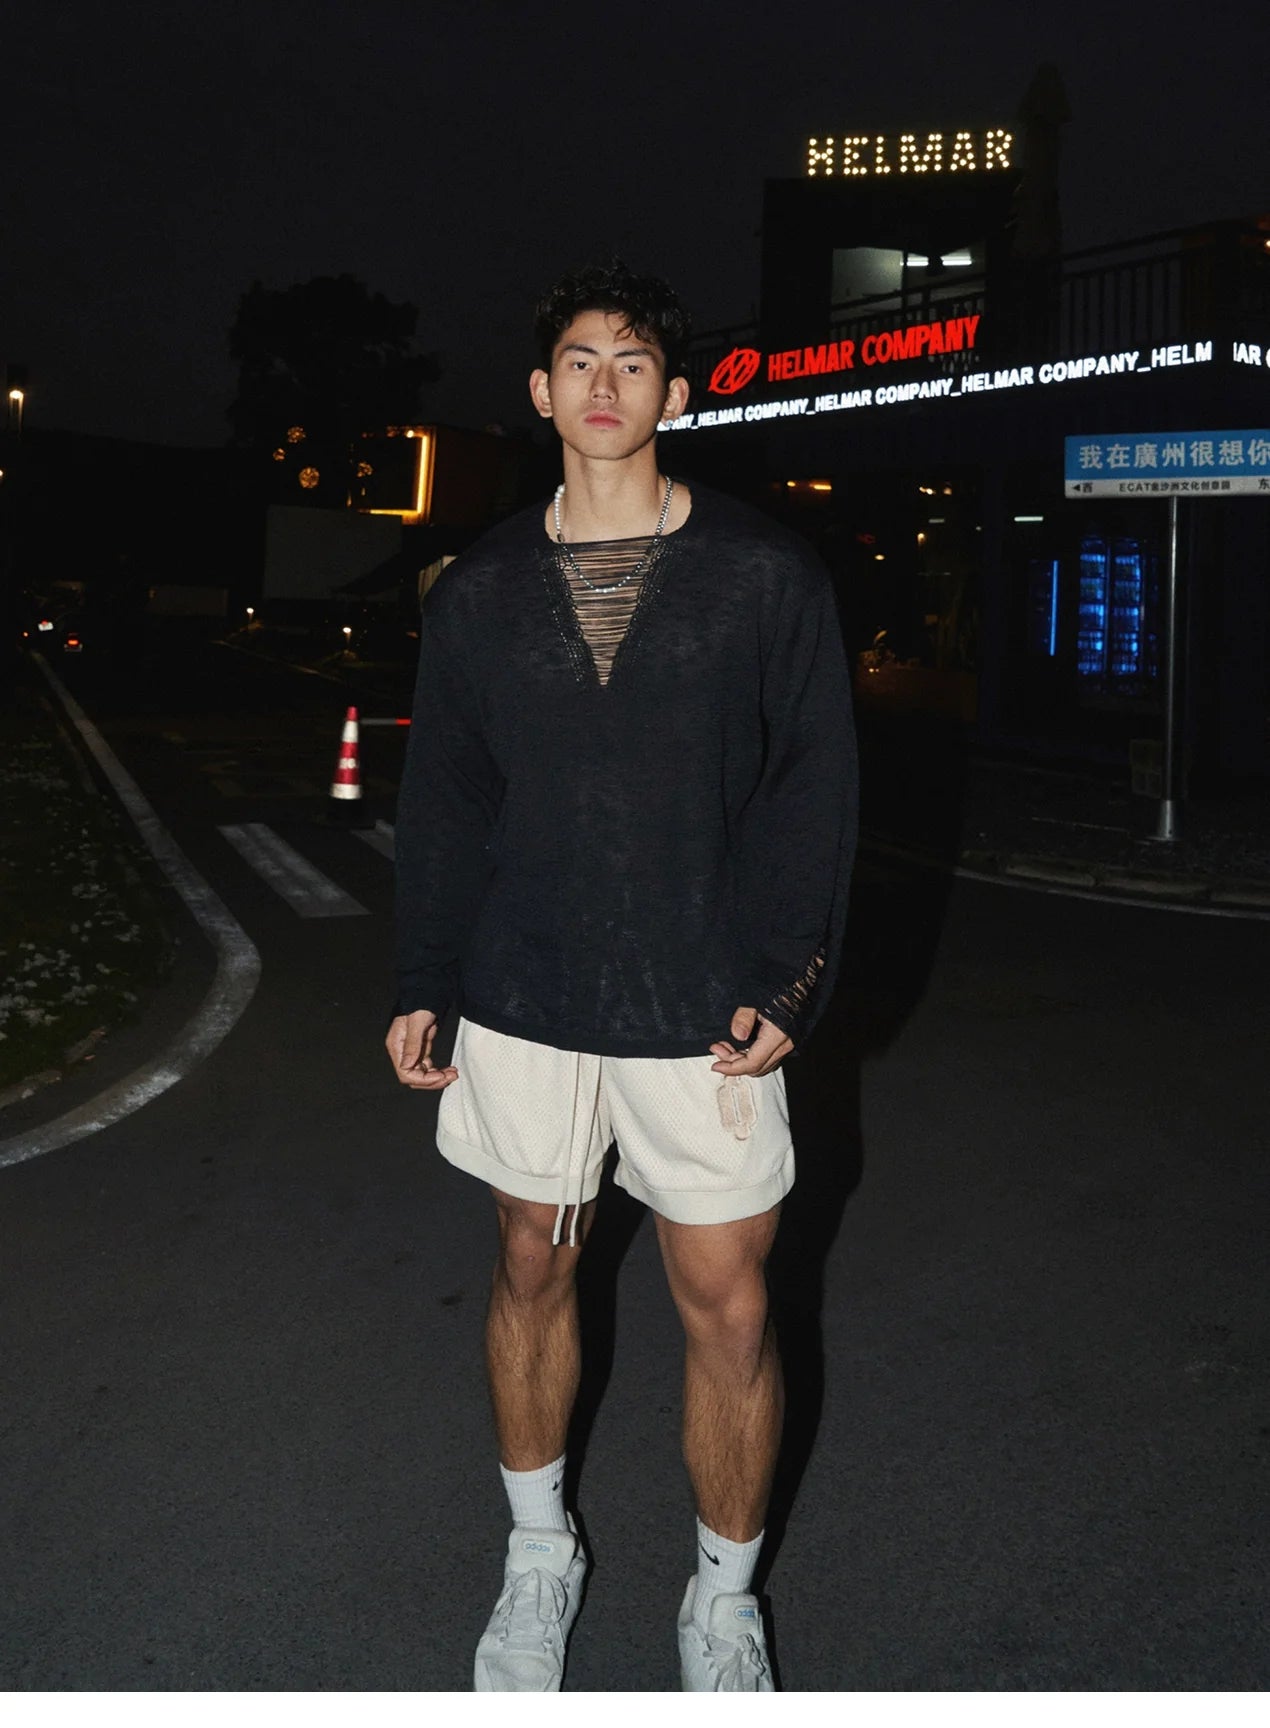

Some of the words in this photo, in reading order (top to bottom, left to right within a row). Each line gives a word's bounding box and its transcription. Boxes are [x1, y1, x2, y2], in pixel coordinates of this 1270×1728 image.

[807, 129, 1013, 177] HELMAR
[767, 340, 855, 382] HELMAR
[861, 315, 980, 366] COMPANY
[1079, 438, 1270, 470] 我在廣州很想你
